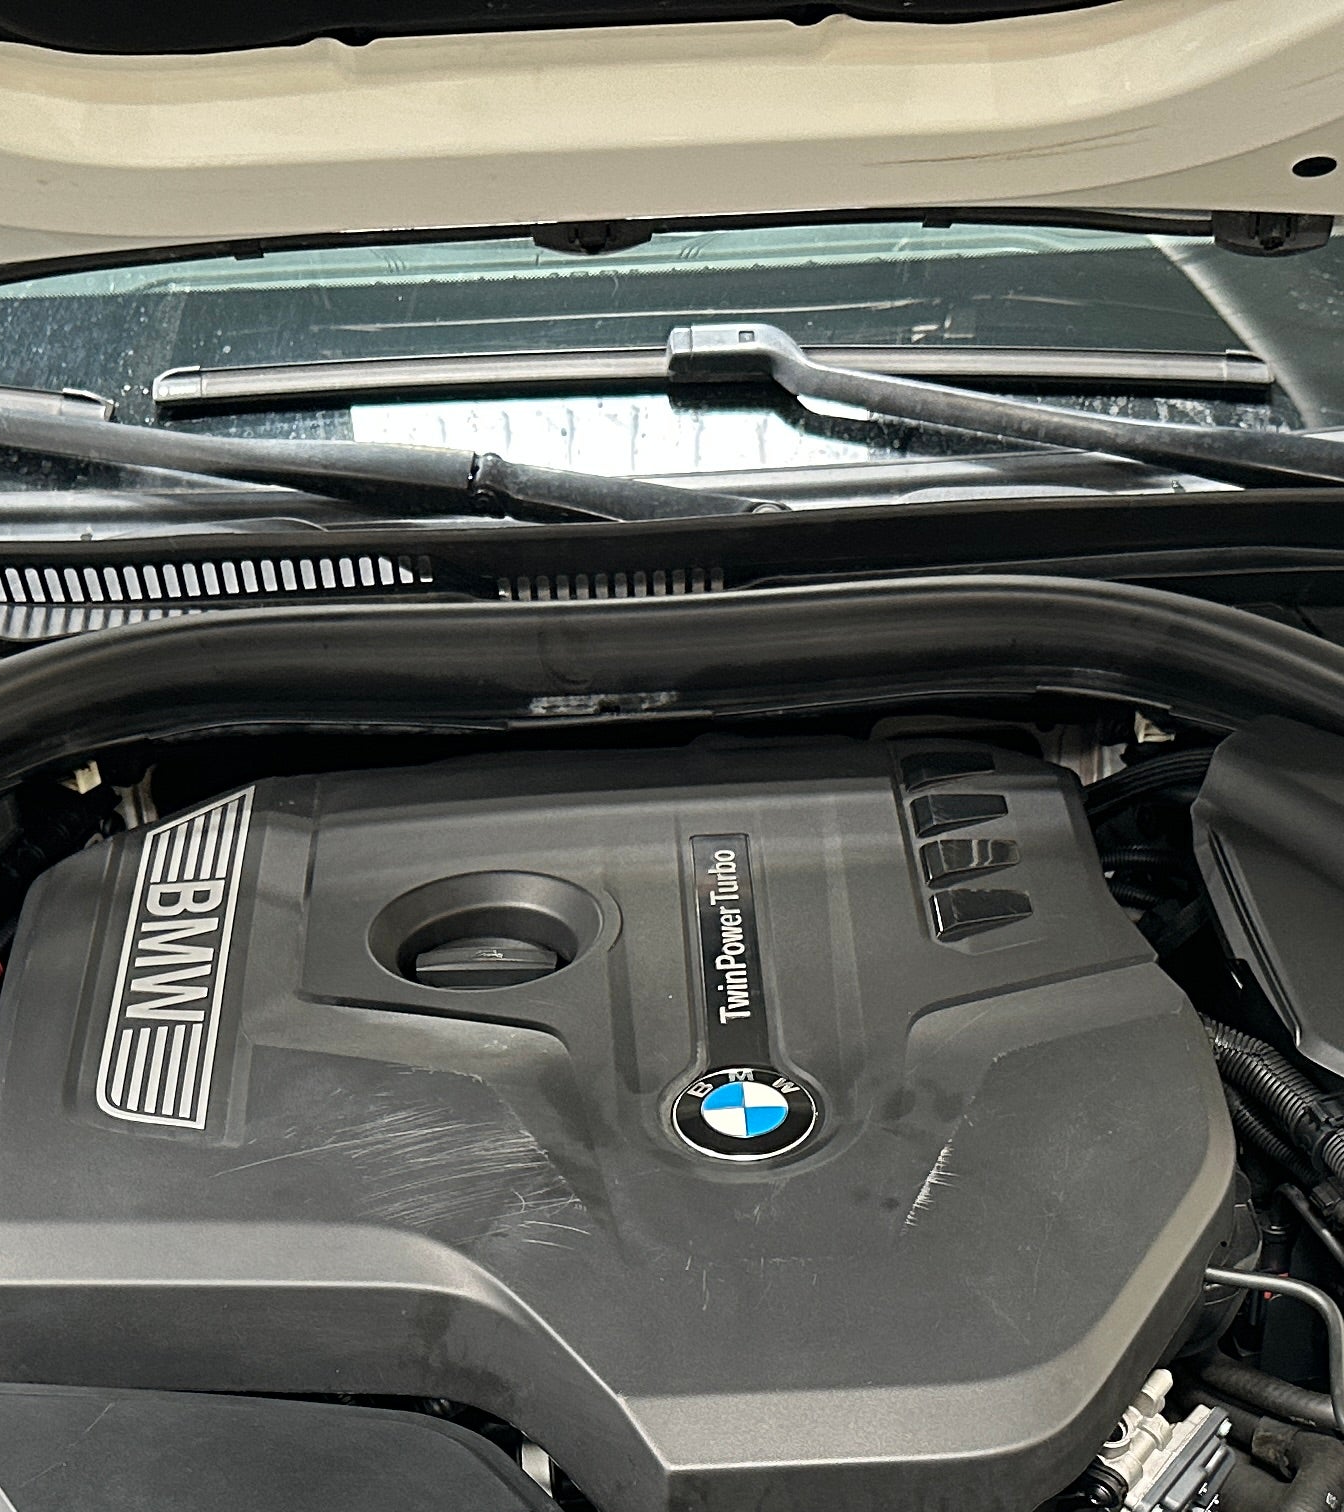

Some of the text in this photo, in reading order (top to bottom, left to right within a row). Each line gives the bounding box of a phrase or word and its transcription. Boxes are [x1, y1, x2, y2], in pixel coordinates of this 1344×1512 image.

[125, 879, 225, 1022] BMW
[707, 849, 752, 1025] TwinPower Turbo
[686, 1069, 801, 1099] BMW
